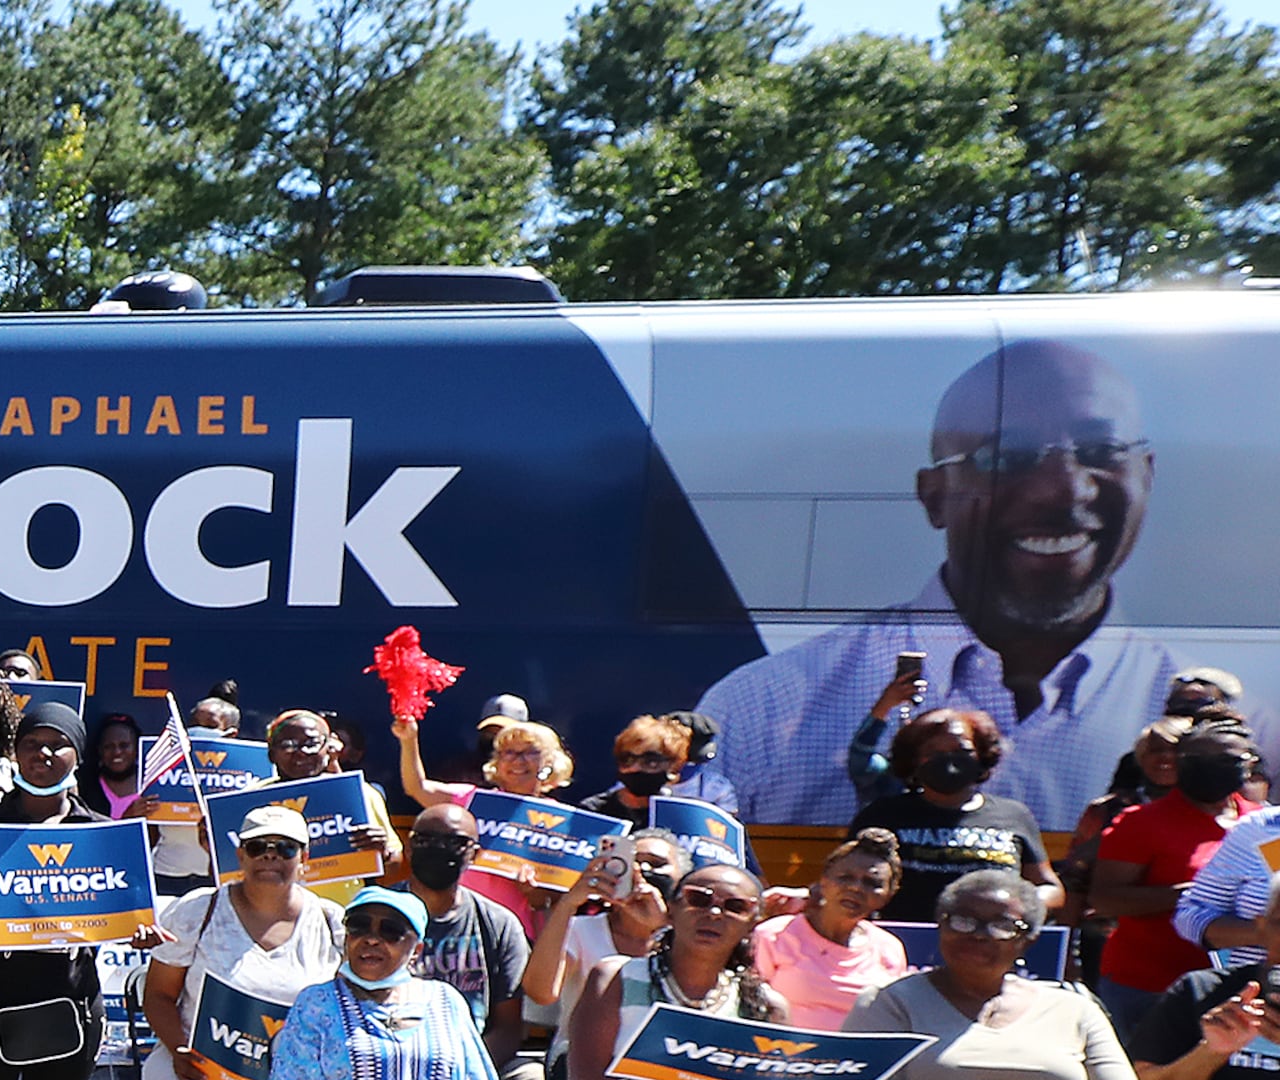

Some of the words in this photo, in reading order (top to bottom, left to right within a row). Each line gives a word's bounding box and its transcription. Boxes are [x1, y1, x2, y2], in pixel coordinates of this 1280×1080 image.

[476, 818, 598, 860] Warnock
[24, 894, 50, 905] U.S.
[53, 892, 97, 904] SENATE
[6, 922, 31, 933] Text
[32, 920, 58, 932] JOIN
[59, 920, 73, 931] to
[74, 919, 109, 930] 52005
[102, 998, 121, 1008] ext
[663, 1036, 869, 1076] Warnock
